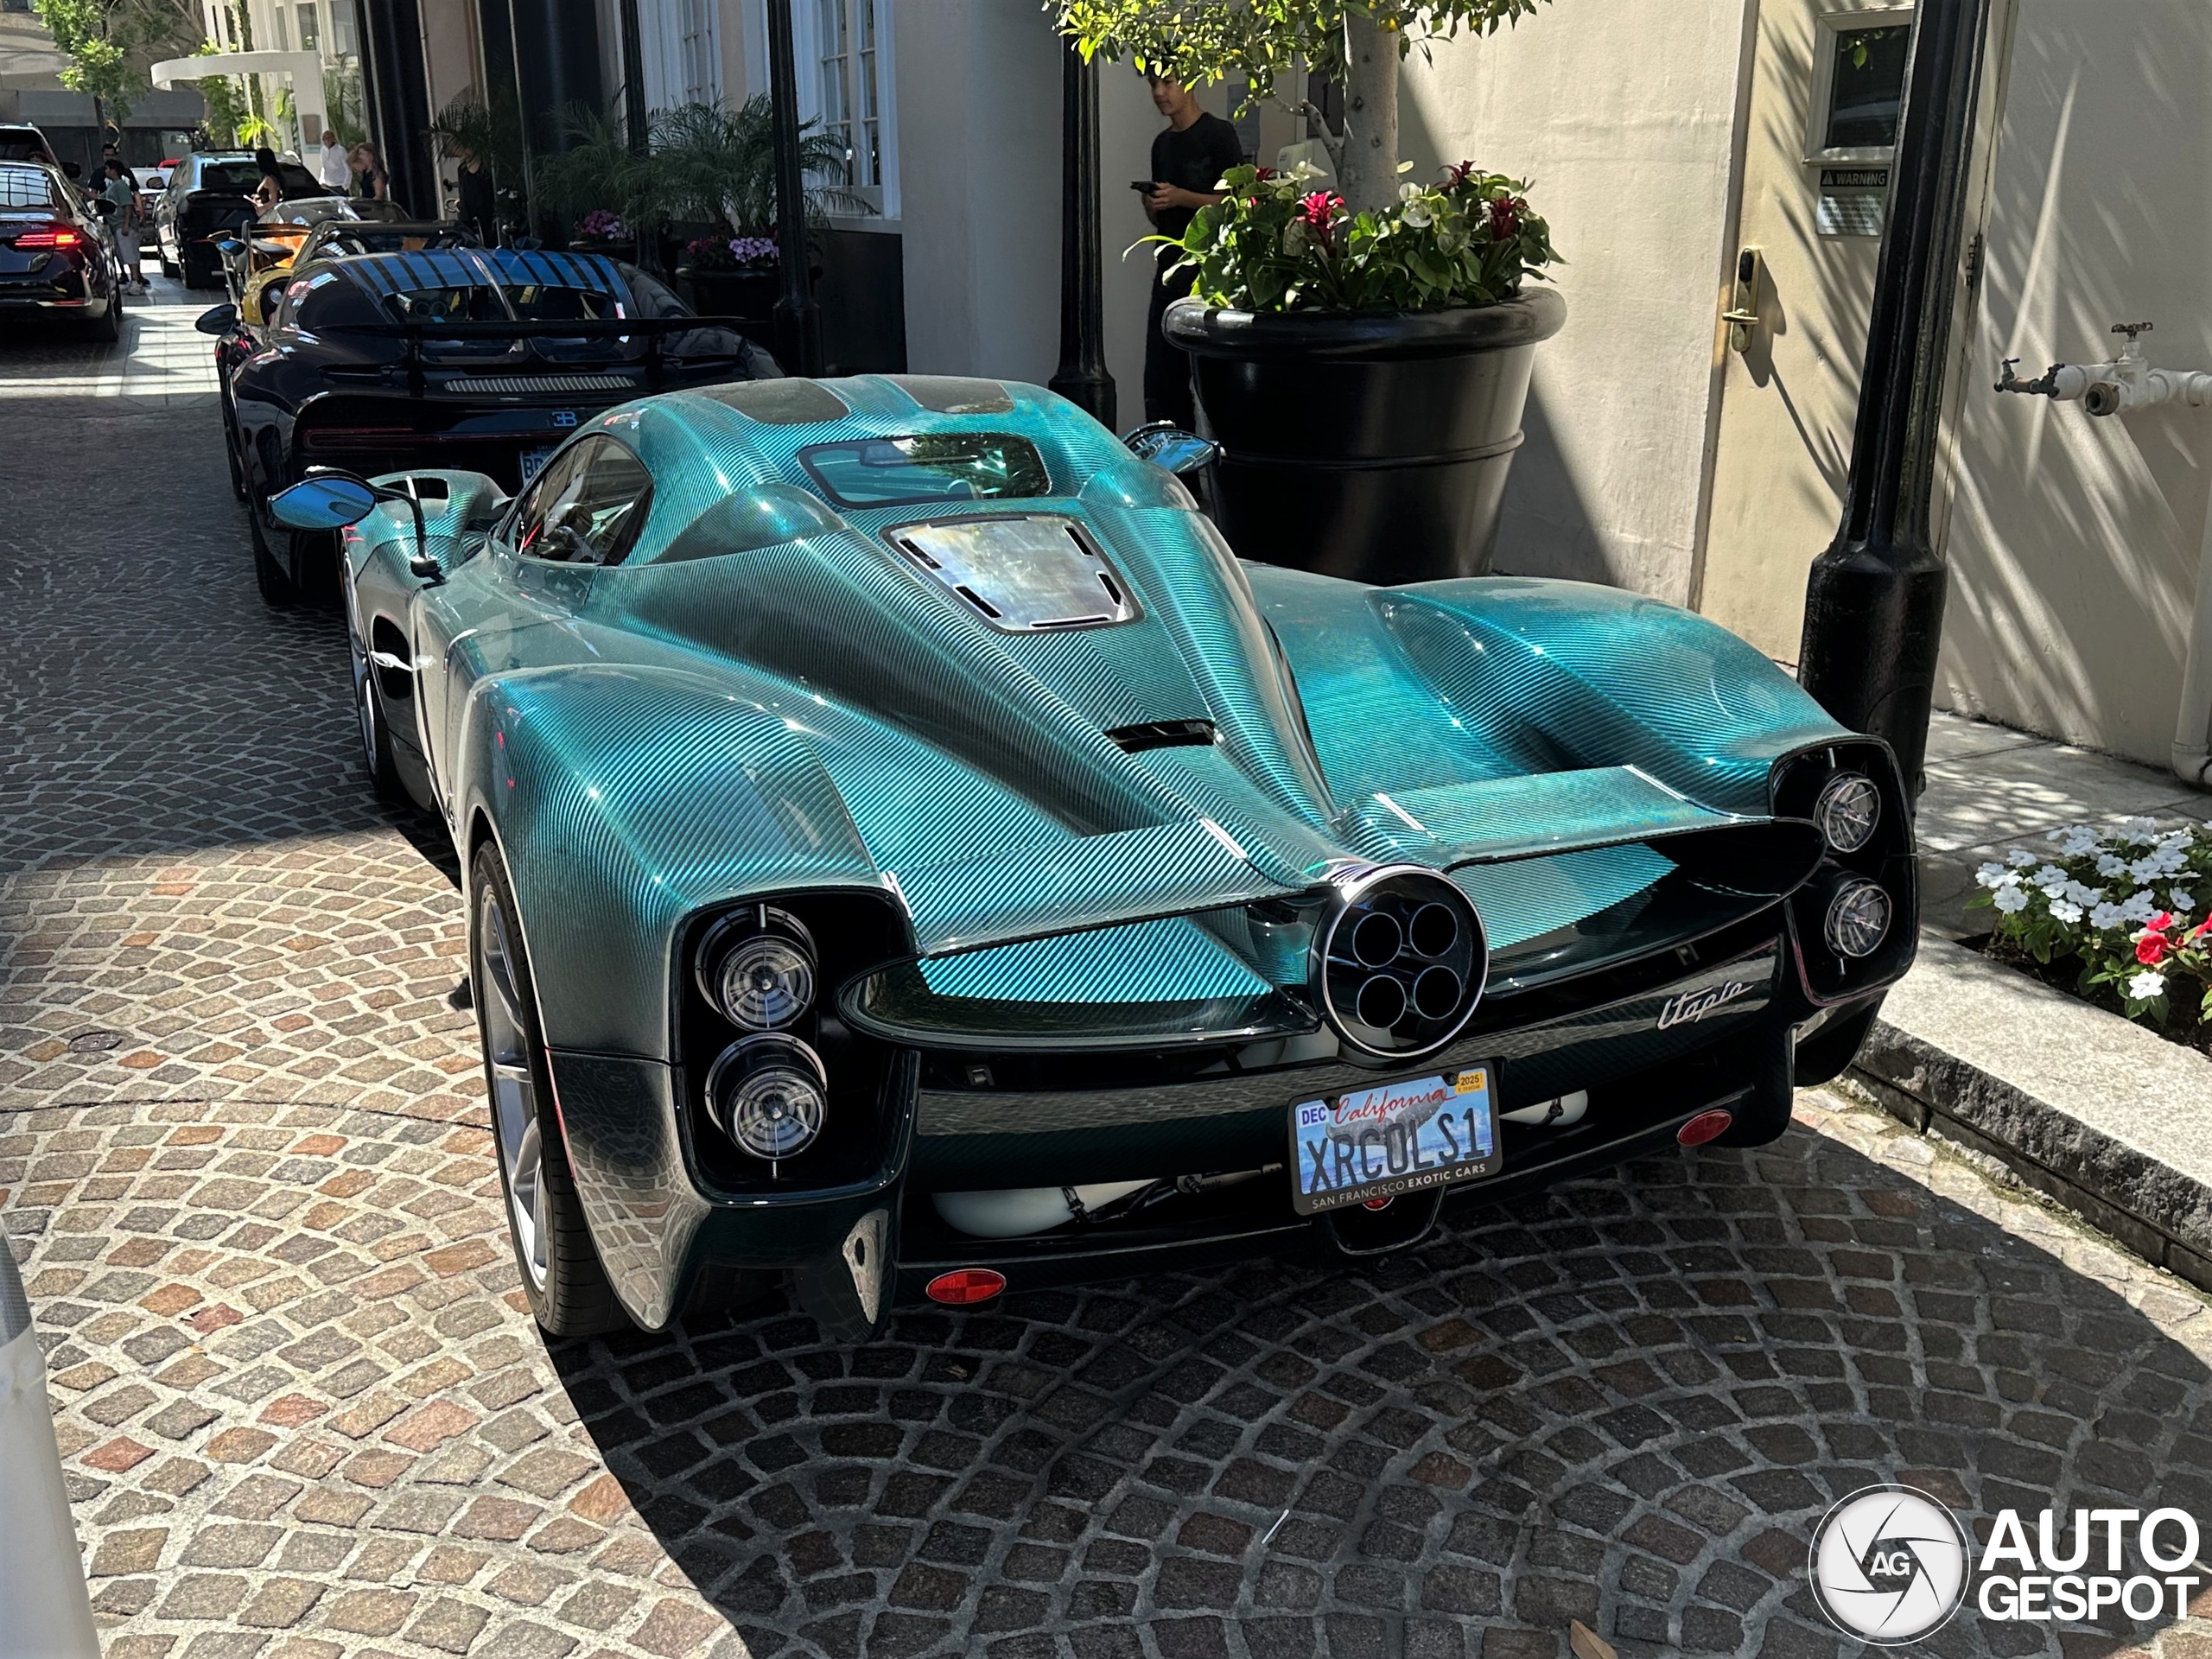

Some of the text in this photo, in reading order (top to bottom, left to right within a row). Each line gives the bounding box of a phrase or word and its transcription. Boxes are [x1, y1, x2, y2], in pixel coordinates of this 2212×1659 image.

[1836, 172, 1886, 186] WARNING
[1656, 980, 1755, 1031] Utopia
[1460, 1074, 1480, 1086] 2025
[1301, 1106, 1327, 1125] DEC
[1334, 1084, 1458, 1125] California
[1312, 1163, 1486, 1210] SAN FRANCISCO EXOTIC CARS
